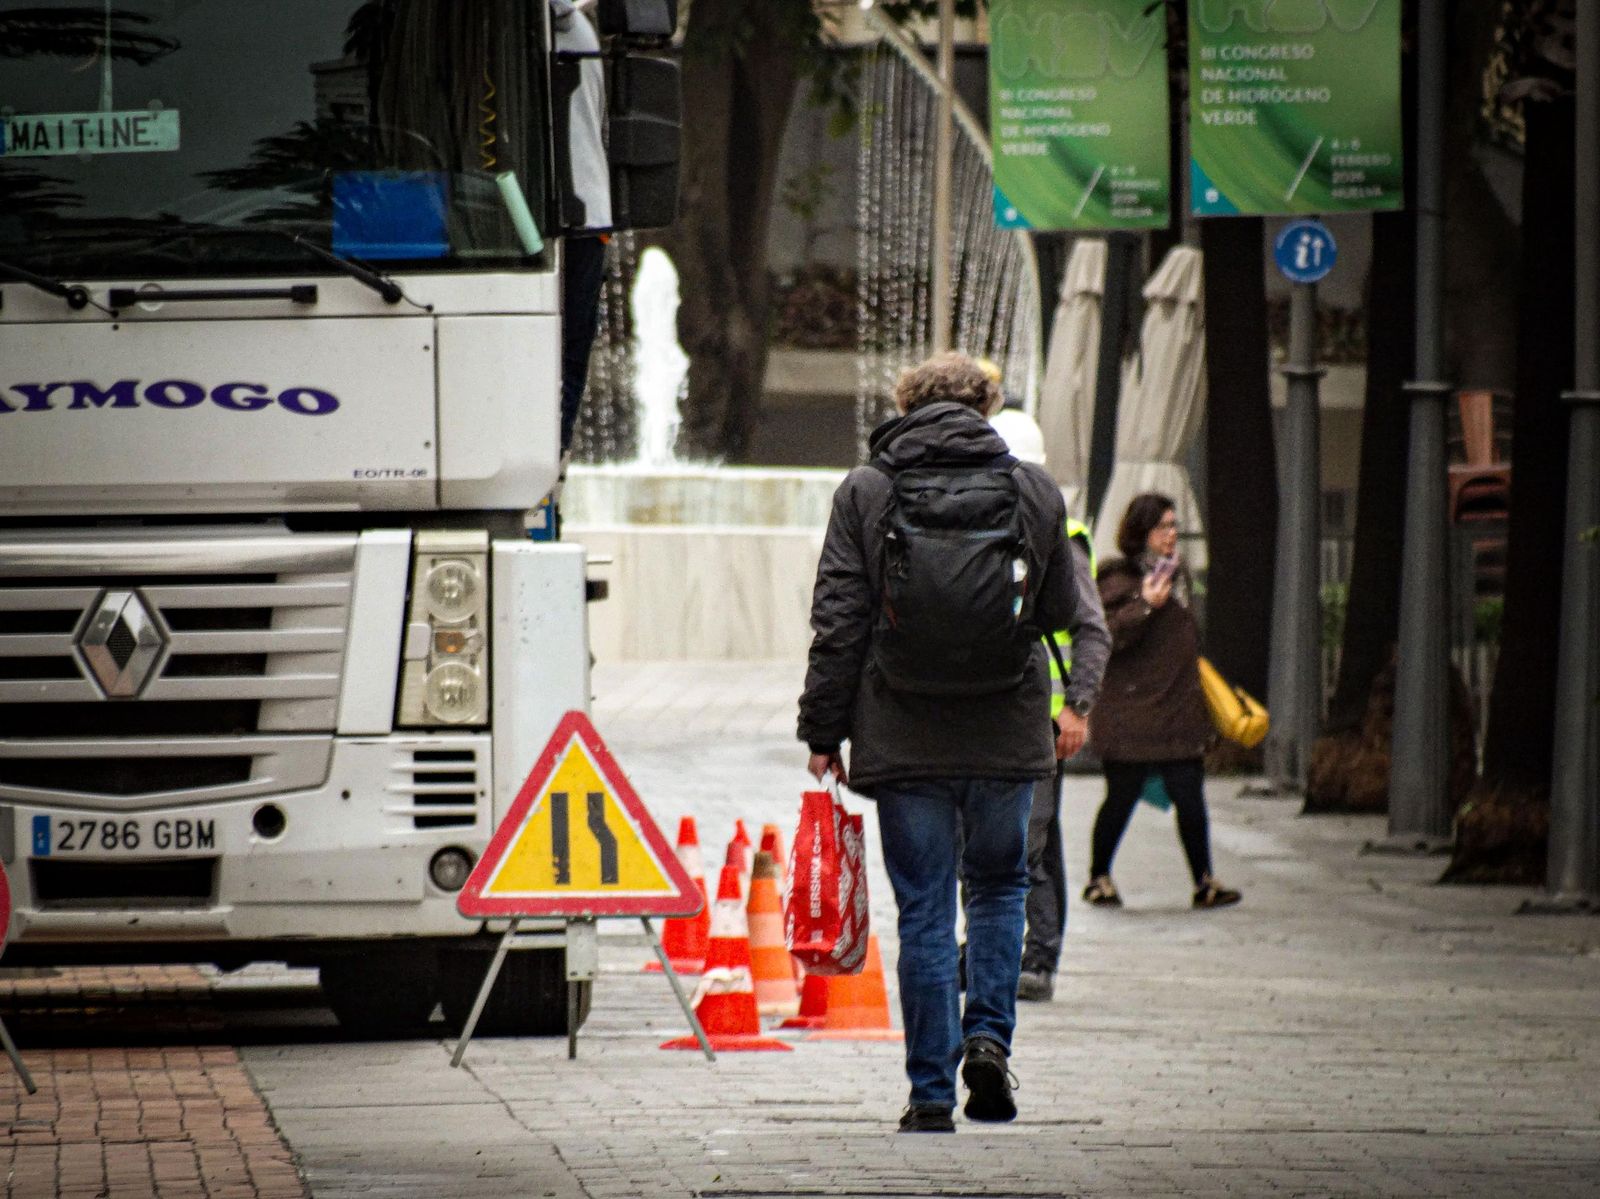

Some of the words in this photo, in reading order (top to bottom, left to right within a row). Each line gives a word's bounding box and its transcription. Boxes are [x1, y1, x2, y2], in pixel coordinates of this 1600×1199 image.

[1220, 44, 1315, 60] CONGRESO
[1200, 66, 1288, 82] NACIONAL
[1201, 87, 1225, 104] DE
[1200, 108, 1258, 127] VERDE
[11, 117, 152, 151] MAITINE
[0, 380, 340, 416] YMOGO
[57, 820, 141, 851] 2786
[153, 819, 216, 850] GBM
